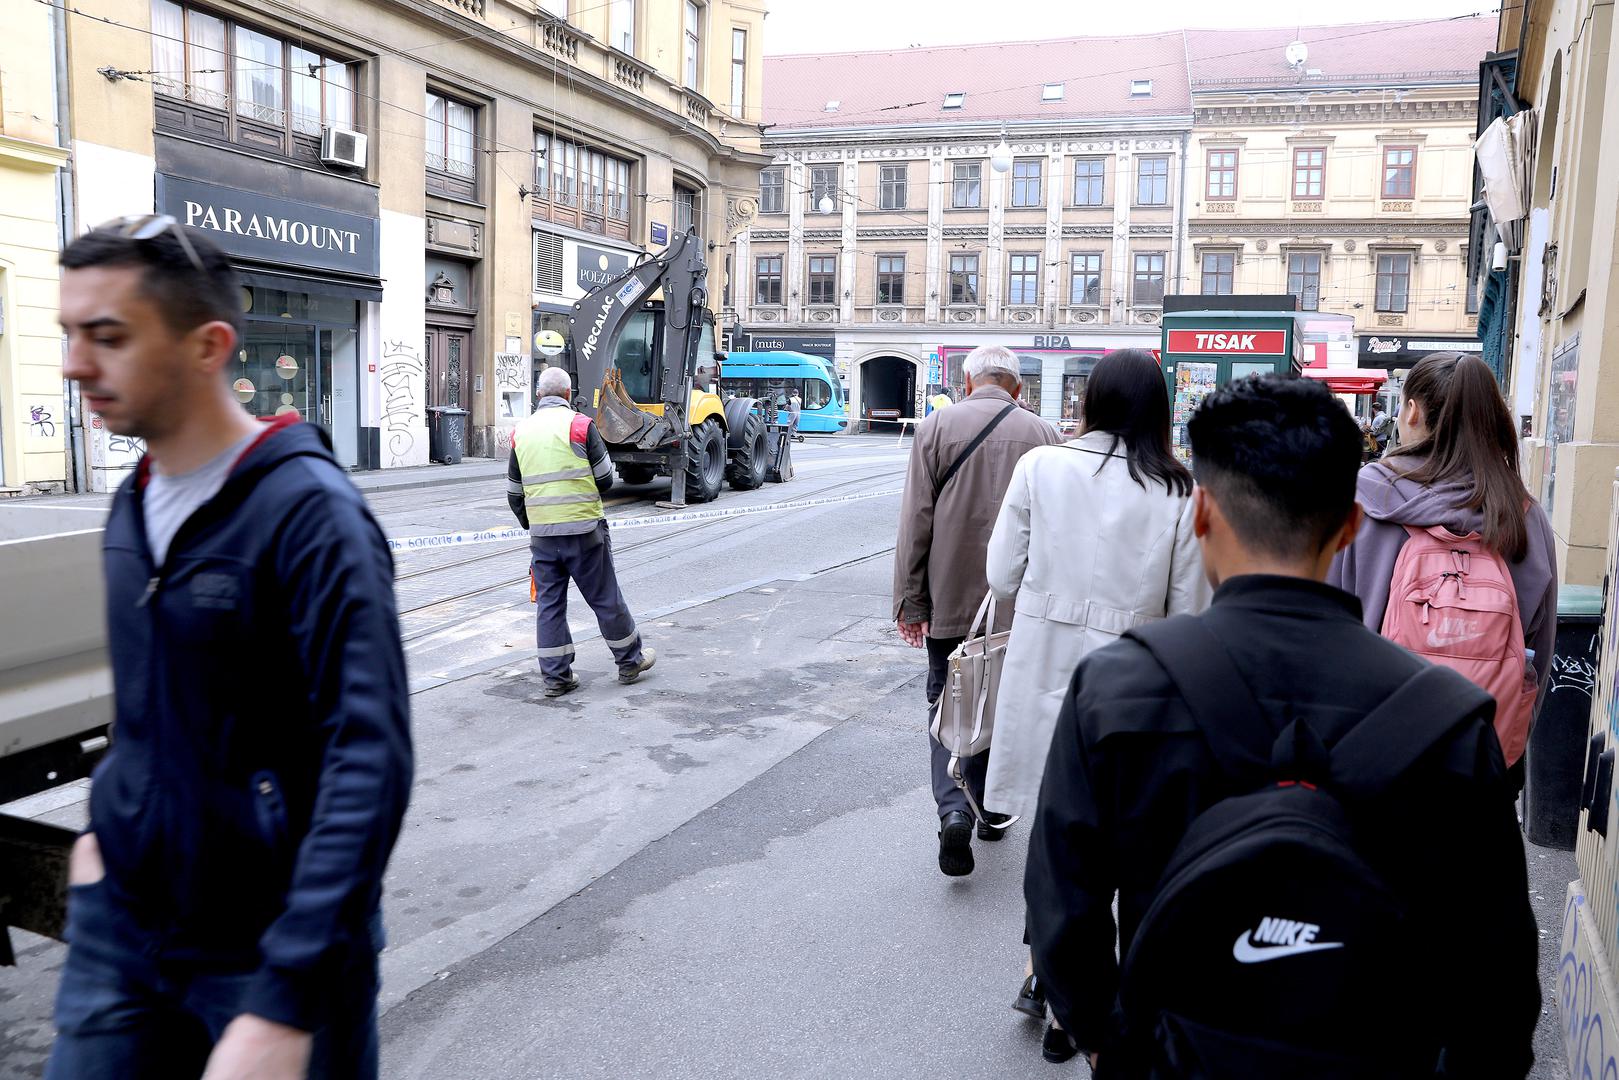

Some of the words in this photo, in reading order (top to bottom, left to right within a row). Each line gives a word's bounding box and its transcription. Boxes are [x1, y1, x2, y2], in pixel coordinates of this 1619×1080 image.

[183, 200, 361, 255] PARAMOUNT
[755, 340, 785, 350] (nuts)
[1033, 335, 1072, 349] BIPA
[1195, 333, 1257, 350] TISAK
[1253, 916, 1320, 945] NIKE
